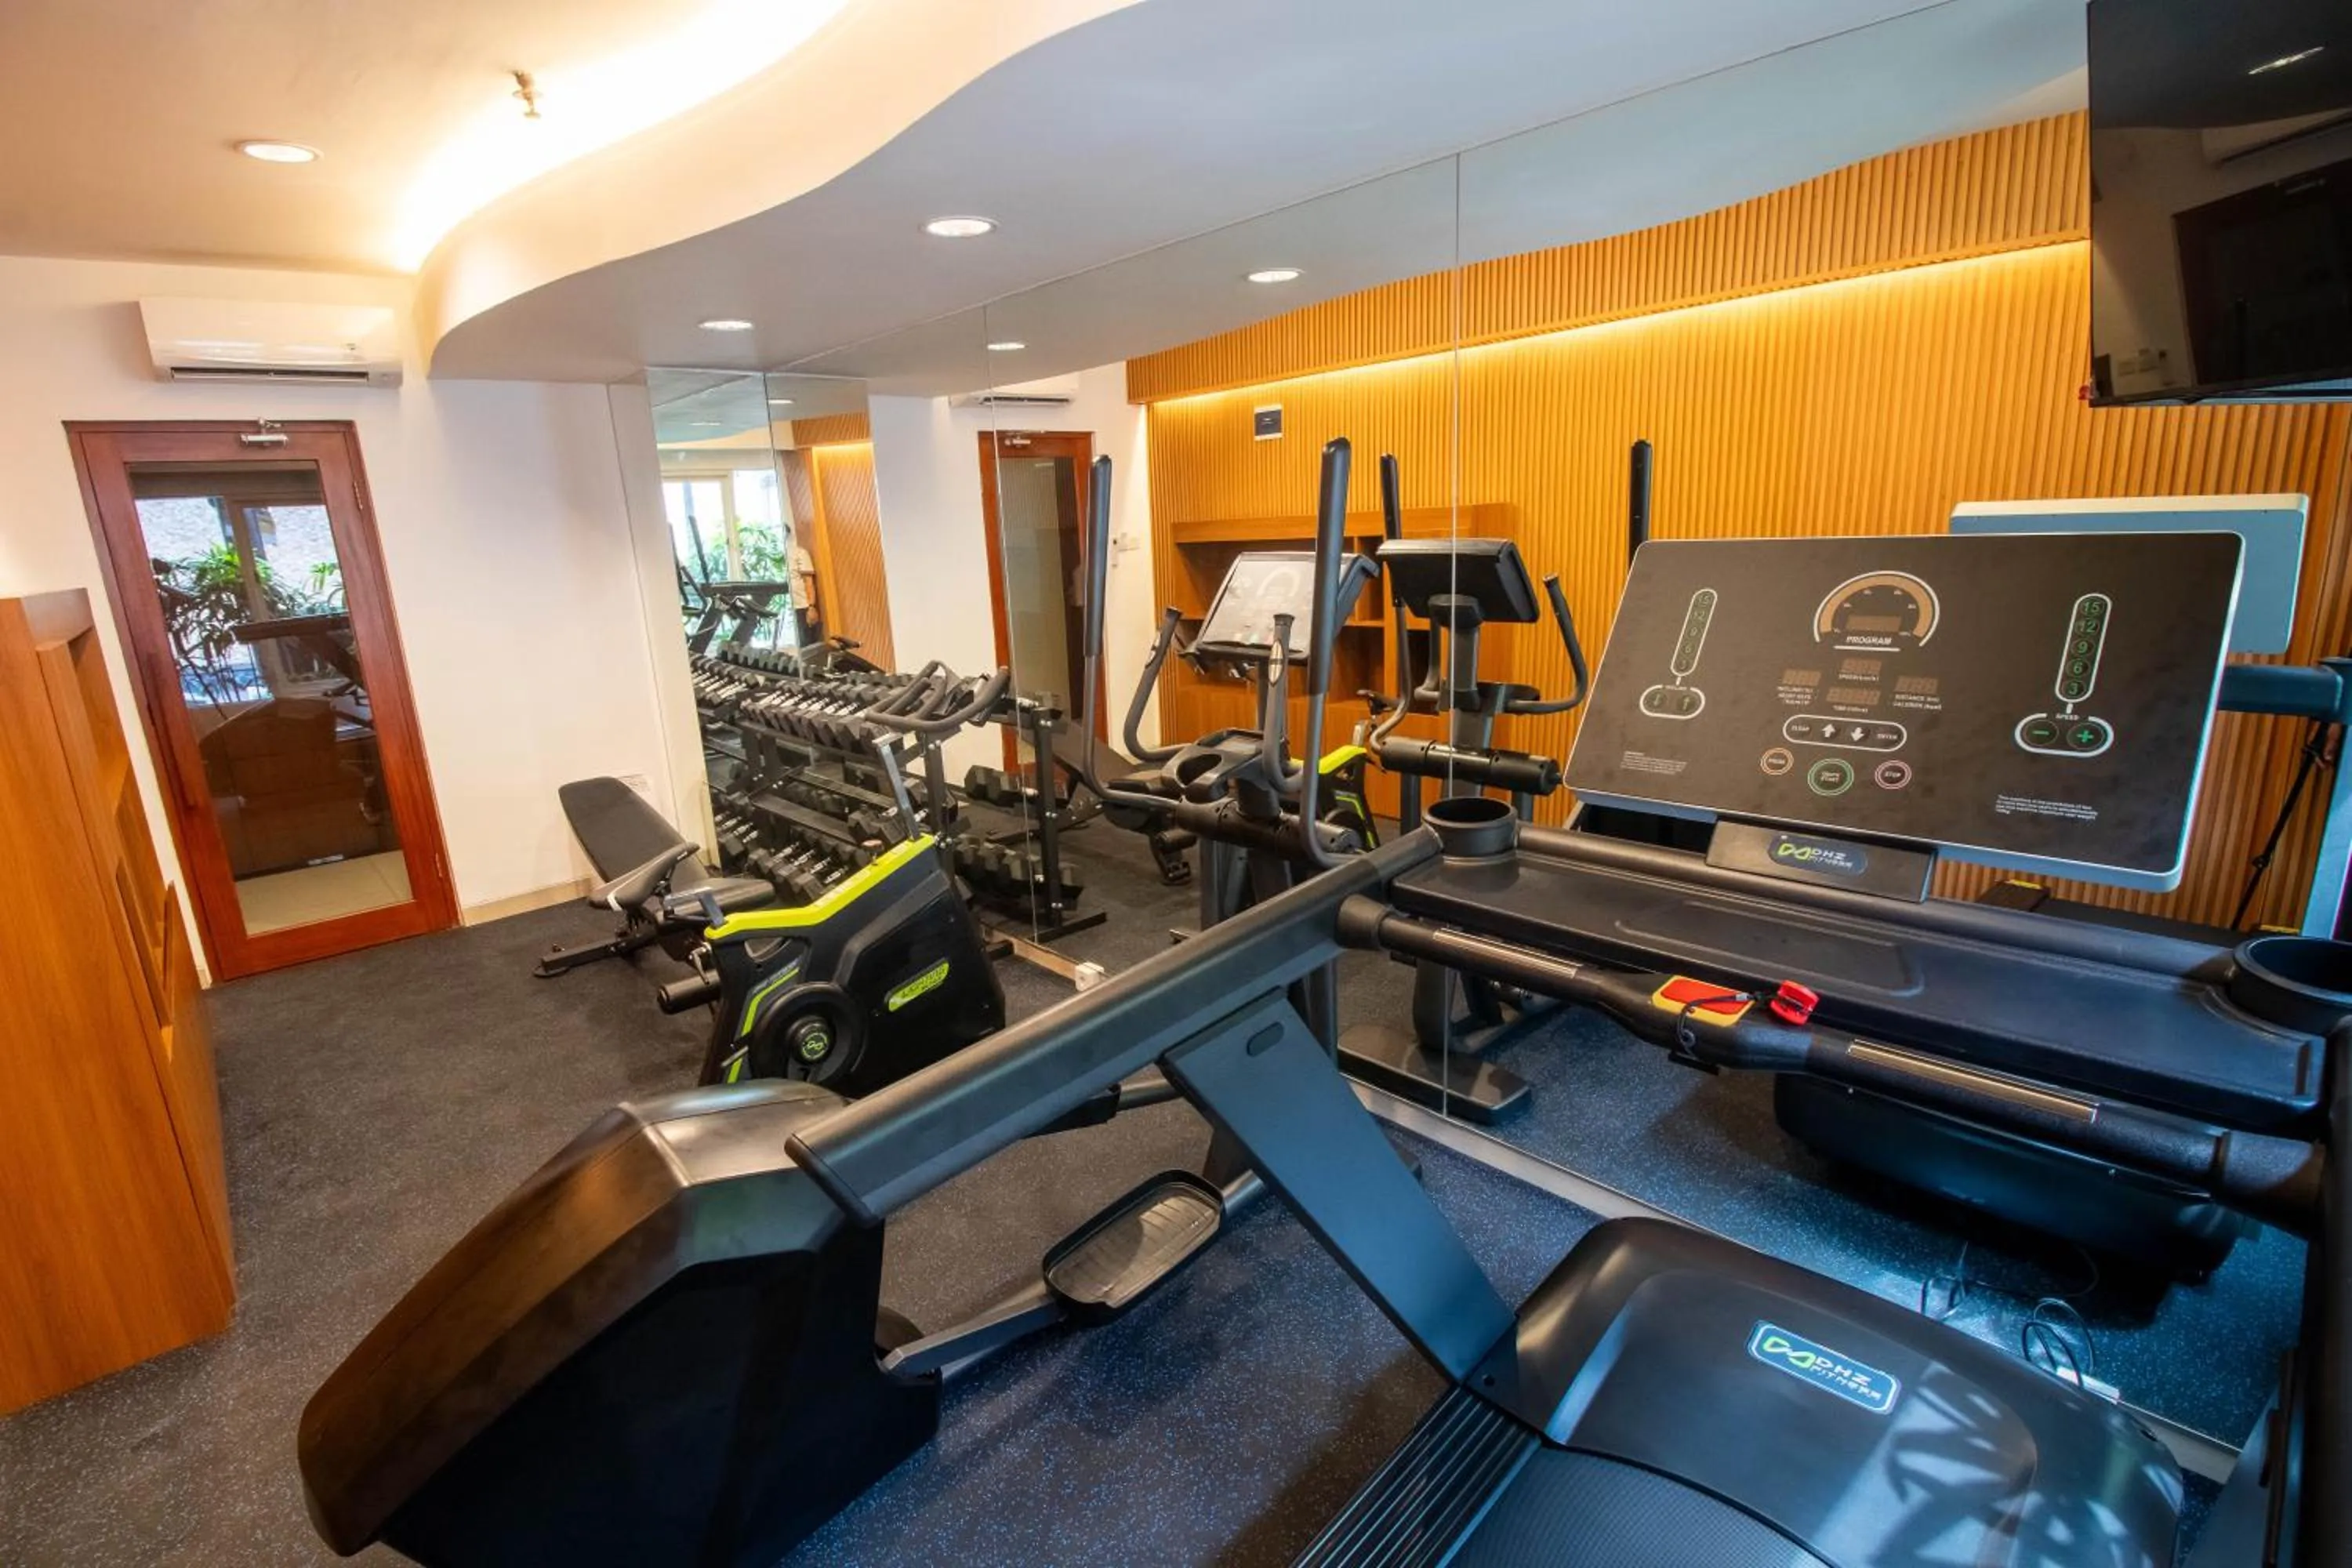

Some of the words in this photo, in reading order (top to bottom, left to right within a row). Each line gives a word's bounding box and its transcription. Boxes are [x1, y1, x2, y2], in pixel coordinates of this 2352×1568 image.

[2084, 601, 2101, 612] 15
[2078, 621, 2096, 633] 12
[1846, 636, 1893, 645] PROGRAM
[2078, 641, 2089, 653] 9
[2073, 662, 2082, 673] 6
[2068, 682, 2078, 695] 3
[1811, 848, 1846, 859] DHZ
[1816, 1356, 1872, 1386] DHZ
[1808, 1365, 1882, 1400] FITNESS
